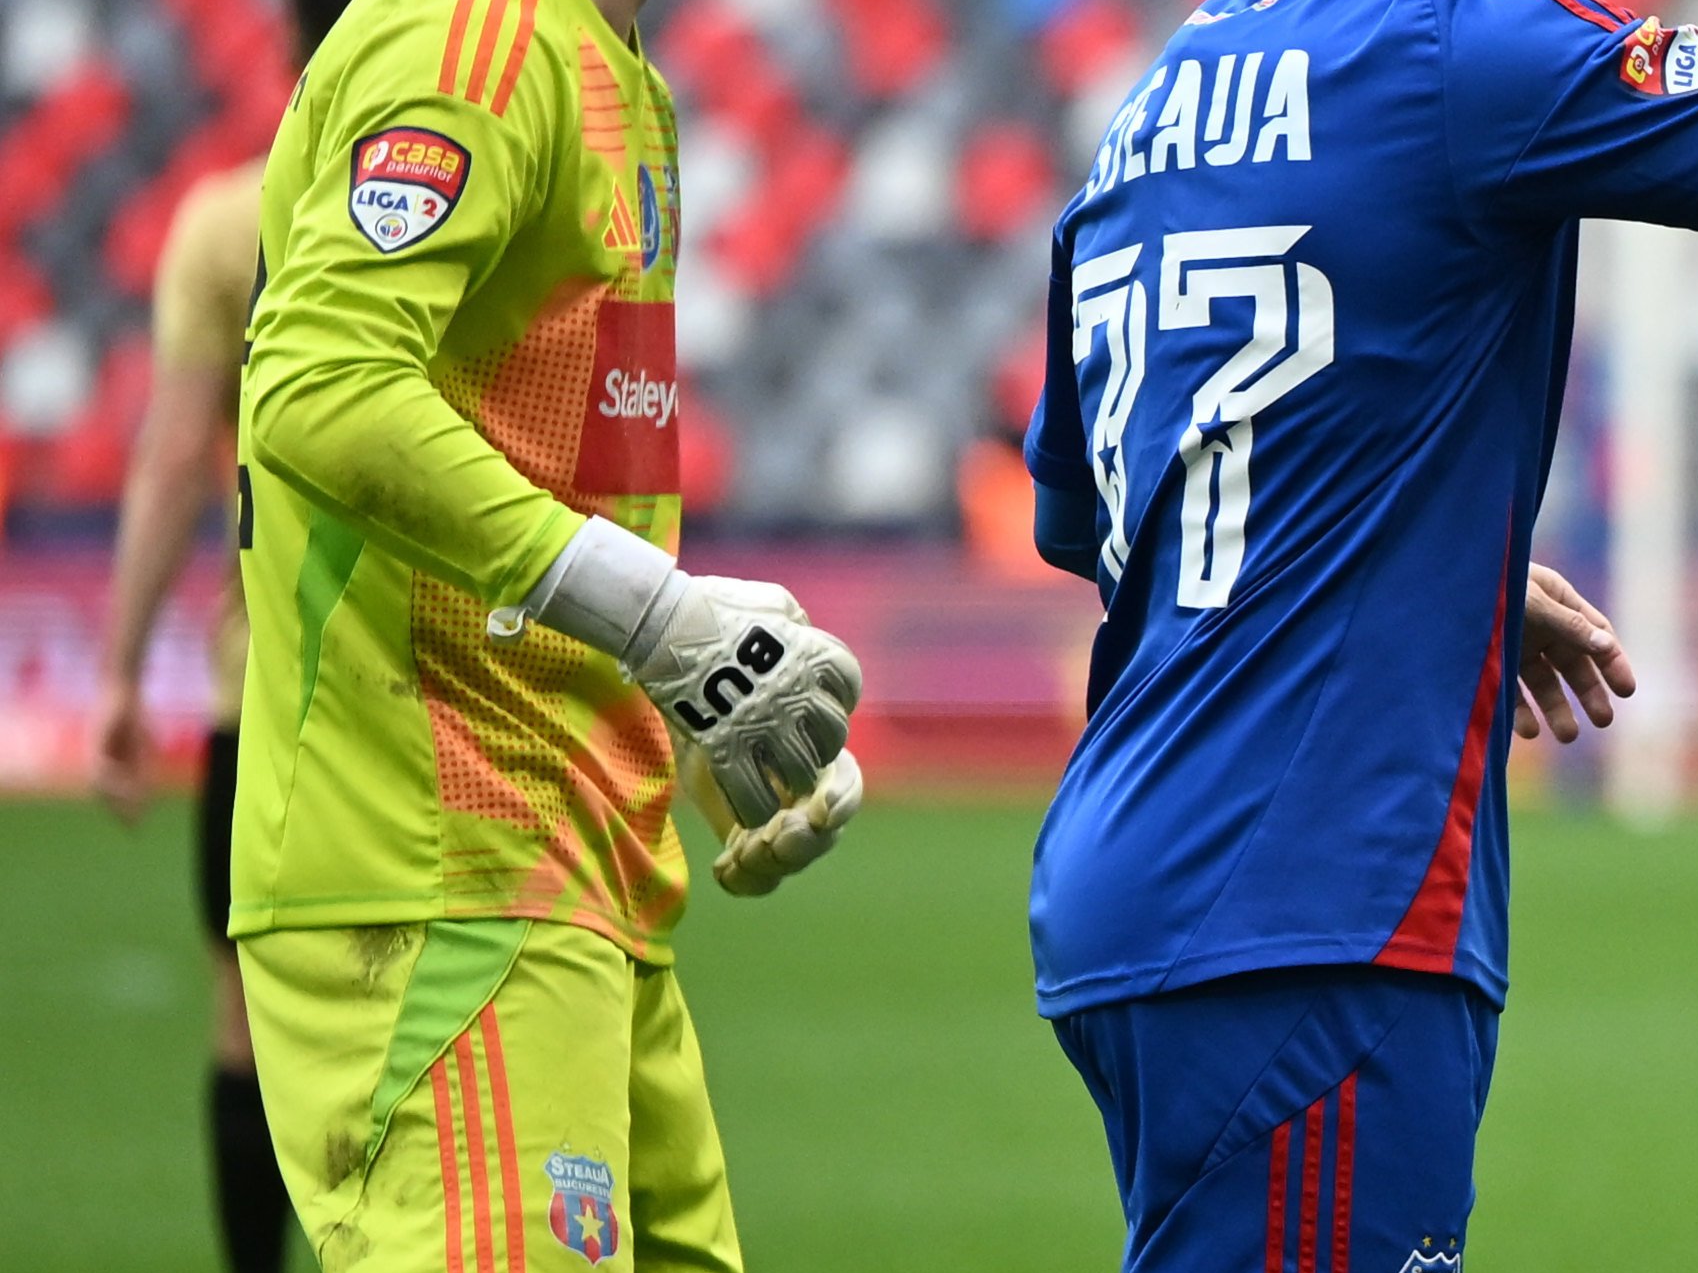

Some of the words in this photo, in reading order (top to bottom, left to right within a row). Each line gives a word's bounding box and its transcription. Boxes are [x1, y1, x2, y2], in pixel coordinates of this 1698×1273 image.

[1673, 44, 1697, 87] LIGA
[386, 160, 453, 183] pariurilor
[391, 141, 460, 175] casa
[356, 190, 409, 212] LIGA
[421, 196, 439, 219] 2
[1072, 225, 1335, 609] 77
[673, 624, 785, 732] BU1
[550, 1155, 611, 1188] STEAUA
